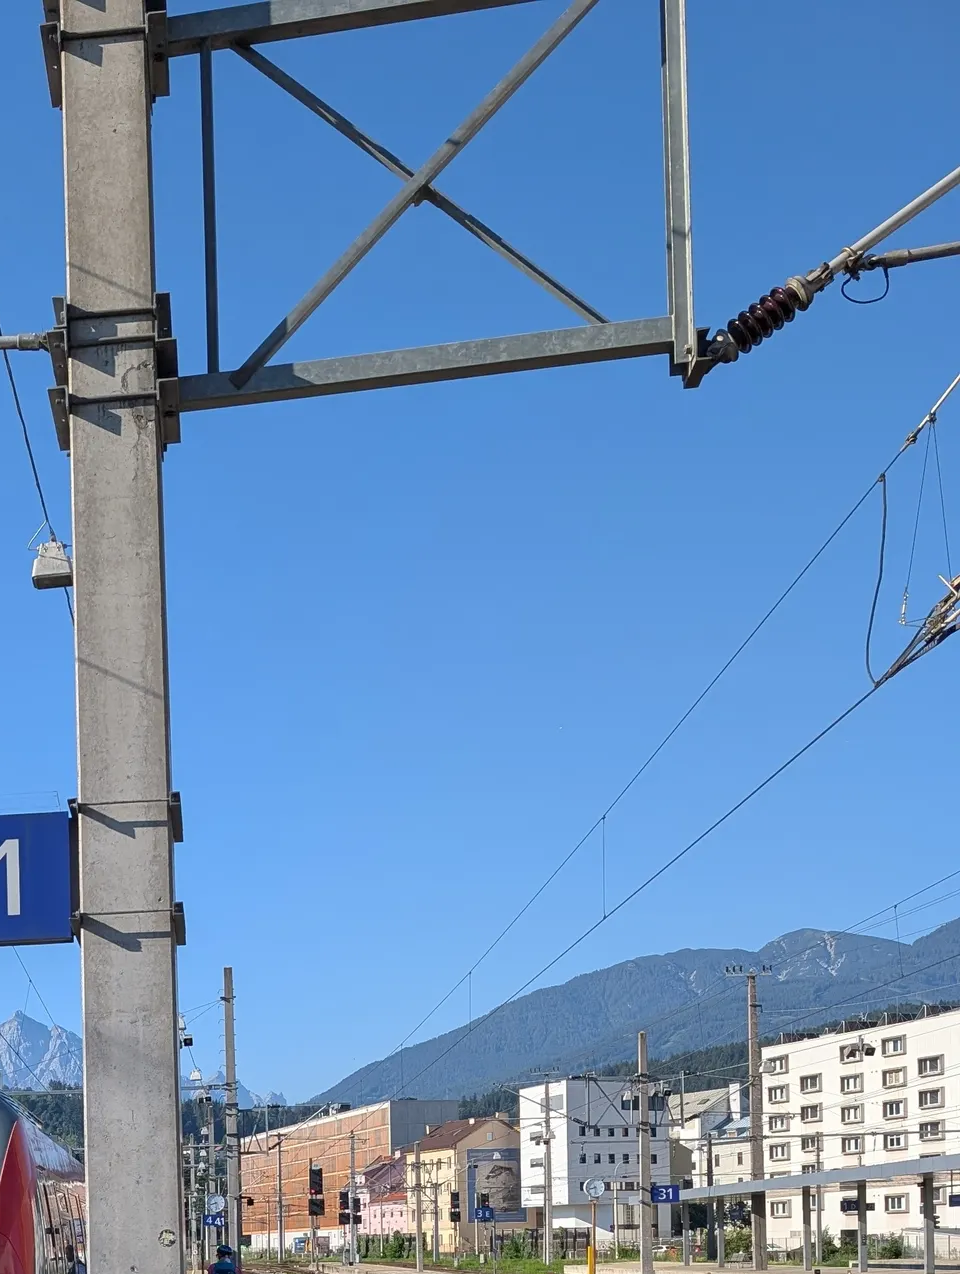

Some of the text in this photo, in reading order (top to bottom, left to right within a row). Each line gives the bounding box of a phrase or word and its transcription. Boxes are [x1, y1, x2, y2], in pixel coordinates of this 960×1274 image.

[658, 1188, 673, 1200] 31
[477, 1209, 483, 1218] 3
[206, 1216, 213, 1225] 4
[214, 1217, 225, 1226] 41
